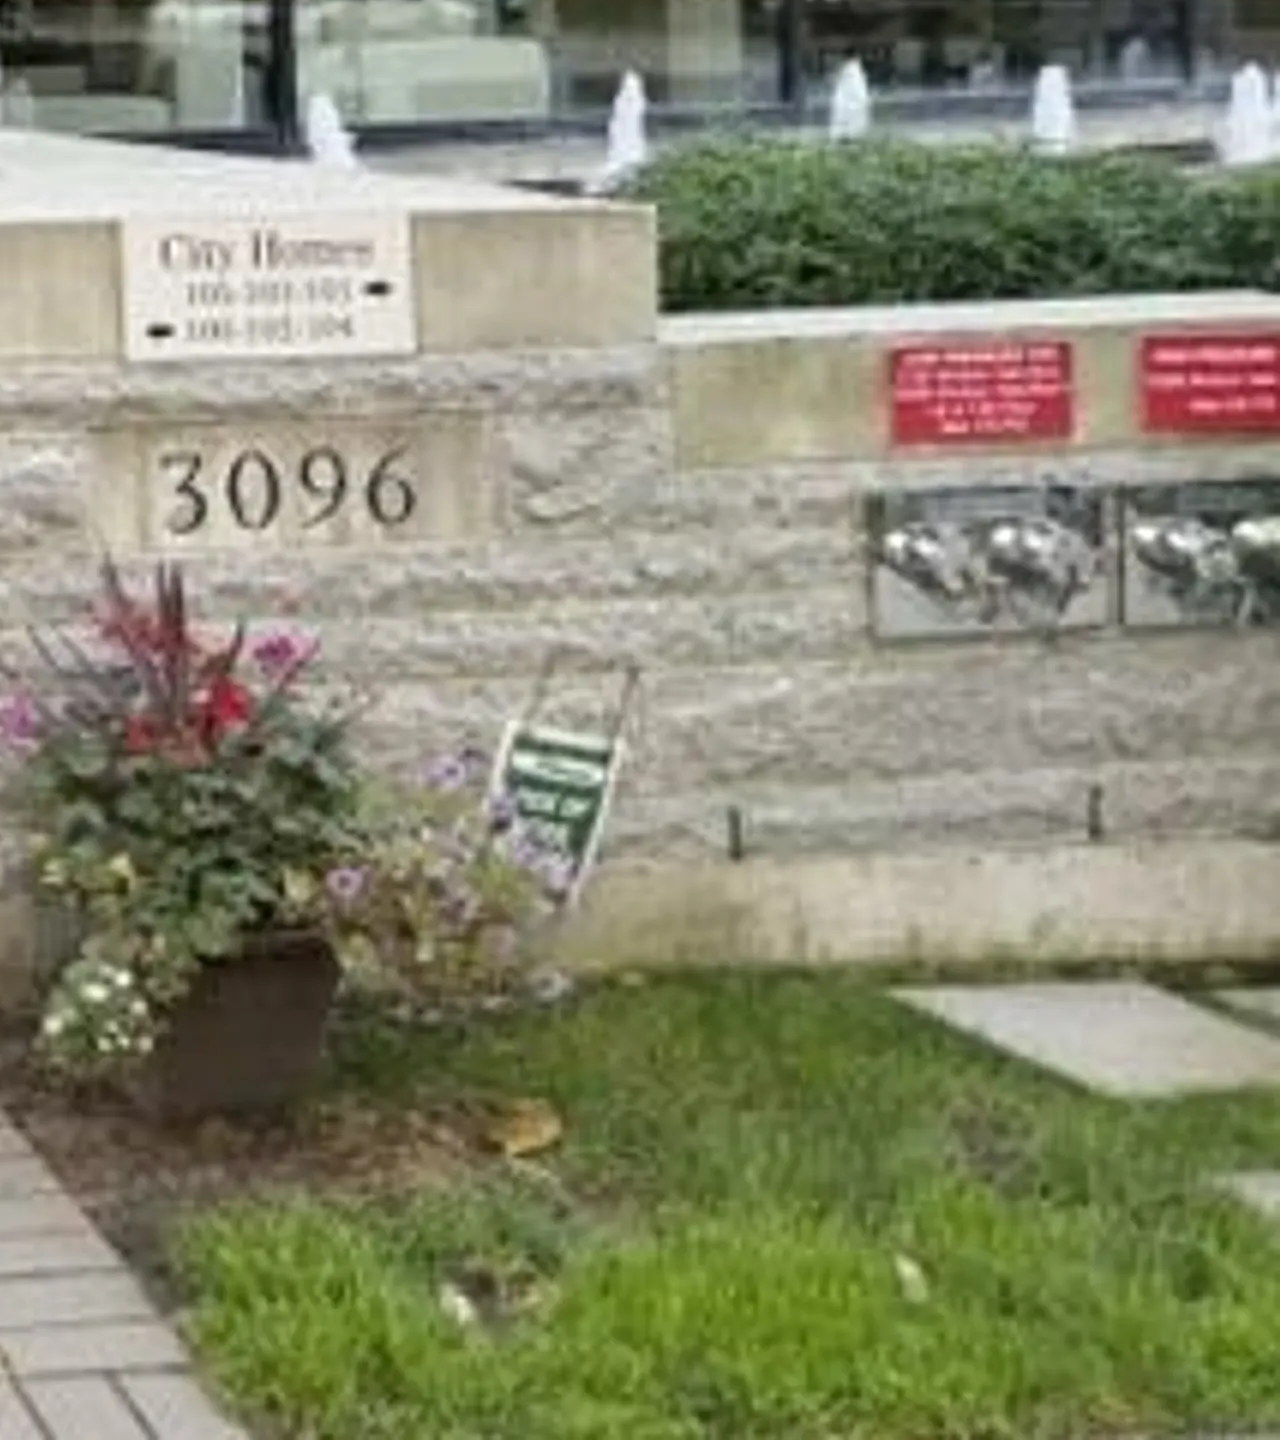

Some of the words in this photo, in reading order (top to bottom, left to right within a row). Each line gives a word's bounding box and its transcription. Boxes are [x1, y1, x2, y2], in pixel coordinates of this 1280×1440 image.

[158, 233, 235, 275] City
[250, 228, 375, 268] Homes
[157, 443, 417, 536] 3096
